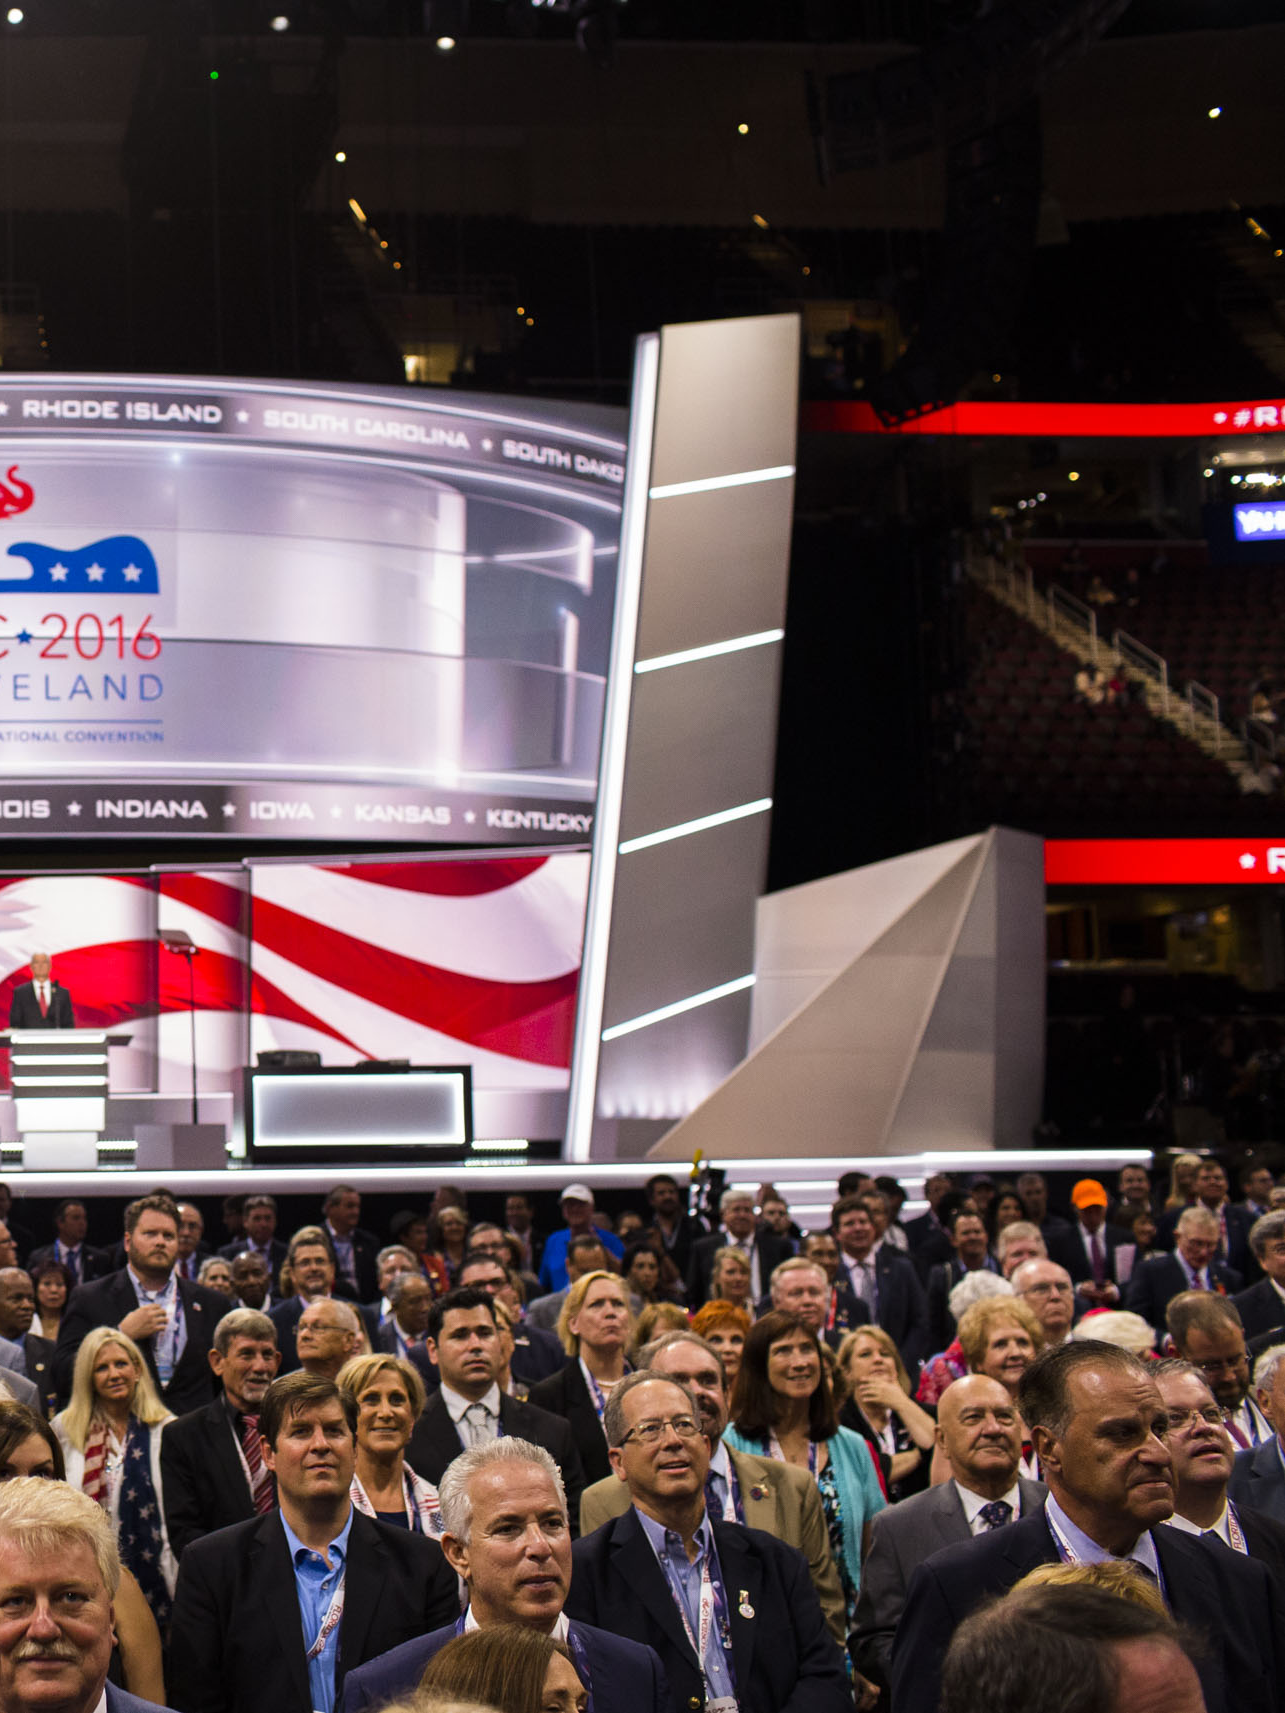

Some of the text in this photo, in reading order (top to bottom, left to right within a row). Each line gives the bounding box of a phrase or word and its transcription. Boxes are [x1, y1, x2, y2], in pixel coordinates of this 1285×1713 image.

[22, 400, 119, 419] RHODE
[125, 402, 223, 424] ISLAND
[263, 410, 350, 434] SOUTH
[354, 415, 470, 449] CAROLINA
[502, 439, 572, 469] SOUTH
[39, 613, 162, 660] 2016
[64, 730, 164, 743] CONVENTION
[96, 799, 208, 819] INDIANA
[250, 801, 314, 820] IOWA
[354, 803, 451, 825] KANSAS
[486, 808, 593, 832] KENTUCKY
